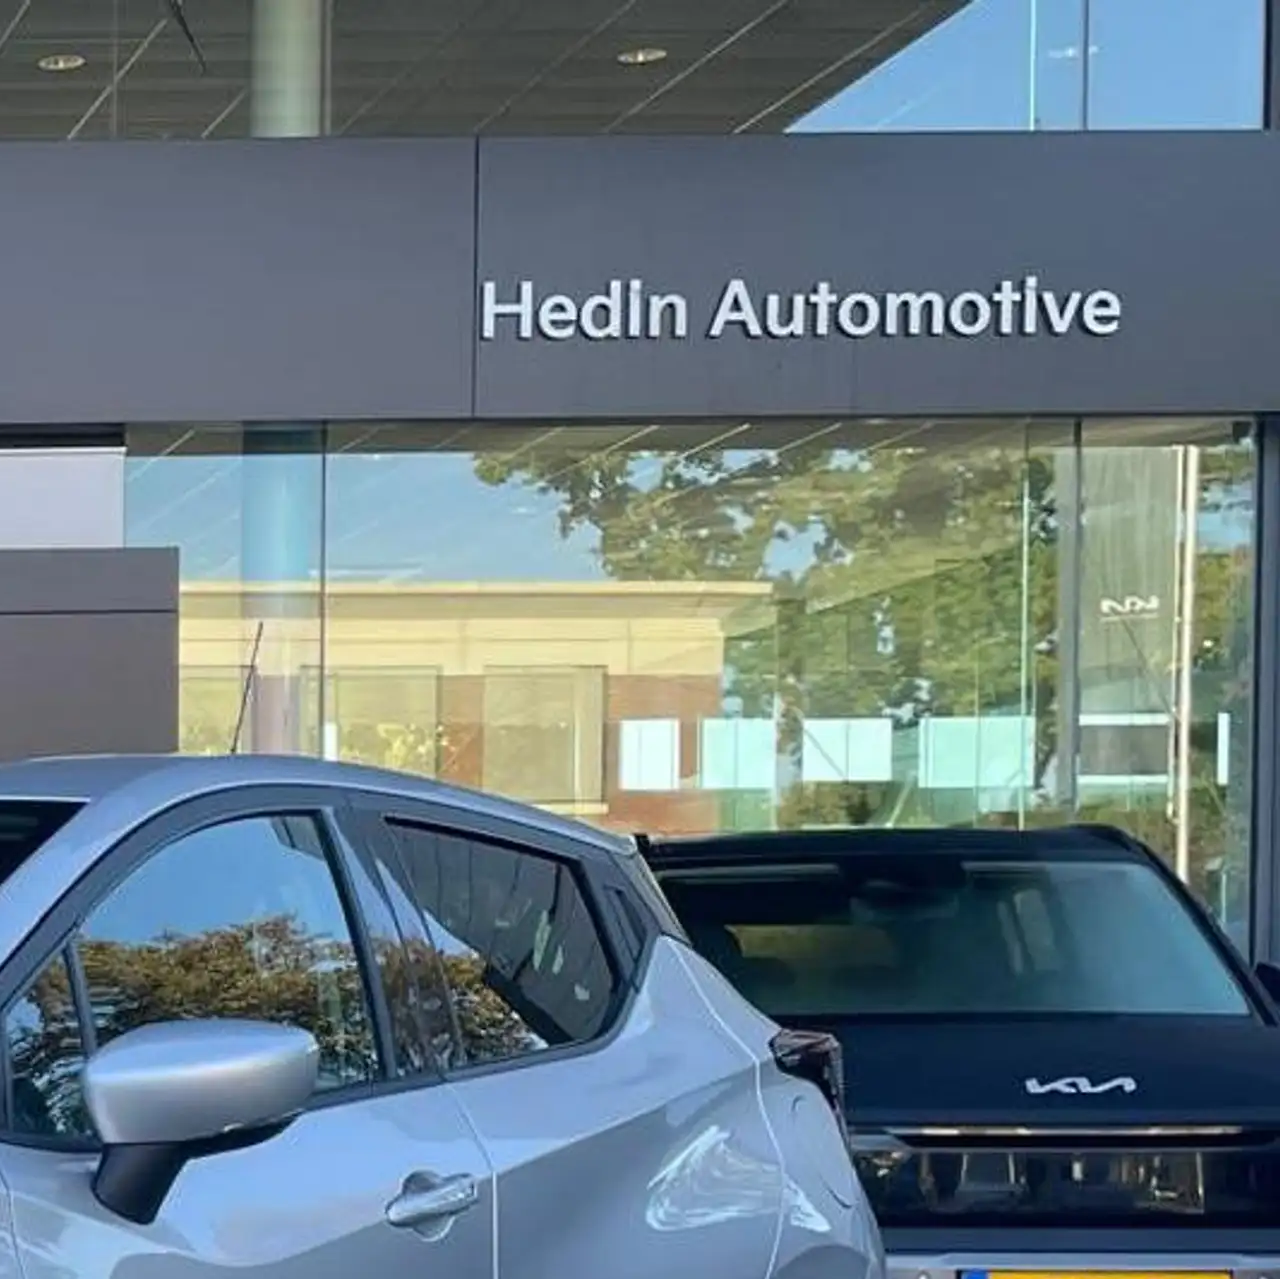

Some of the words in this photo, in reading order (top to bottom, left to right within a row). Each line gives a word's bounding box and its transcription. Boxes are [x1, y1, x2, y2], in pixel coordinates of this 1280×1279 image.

[483, 278, 692, 338] Hedin
[710, 275, 1121, 337] Automotive
[1025, 1077, 1137, 1094] KIA
